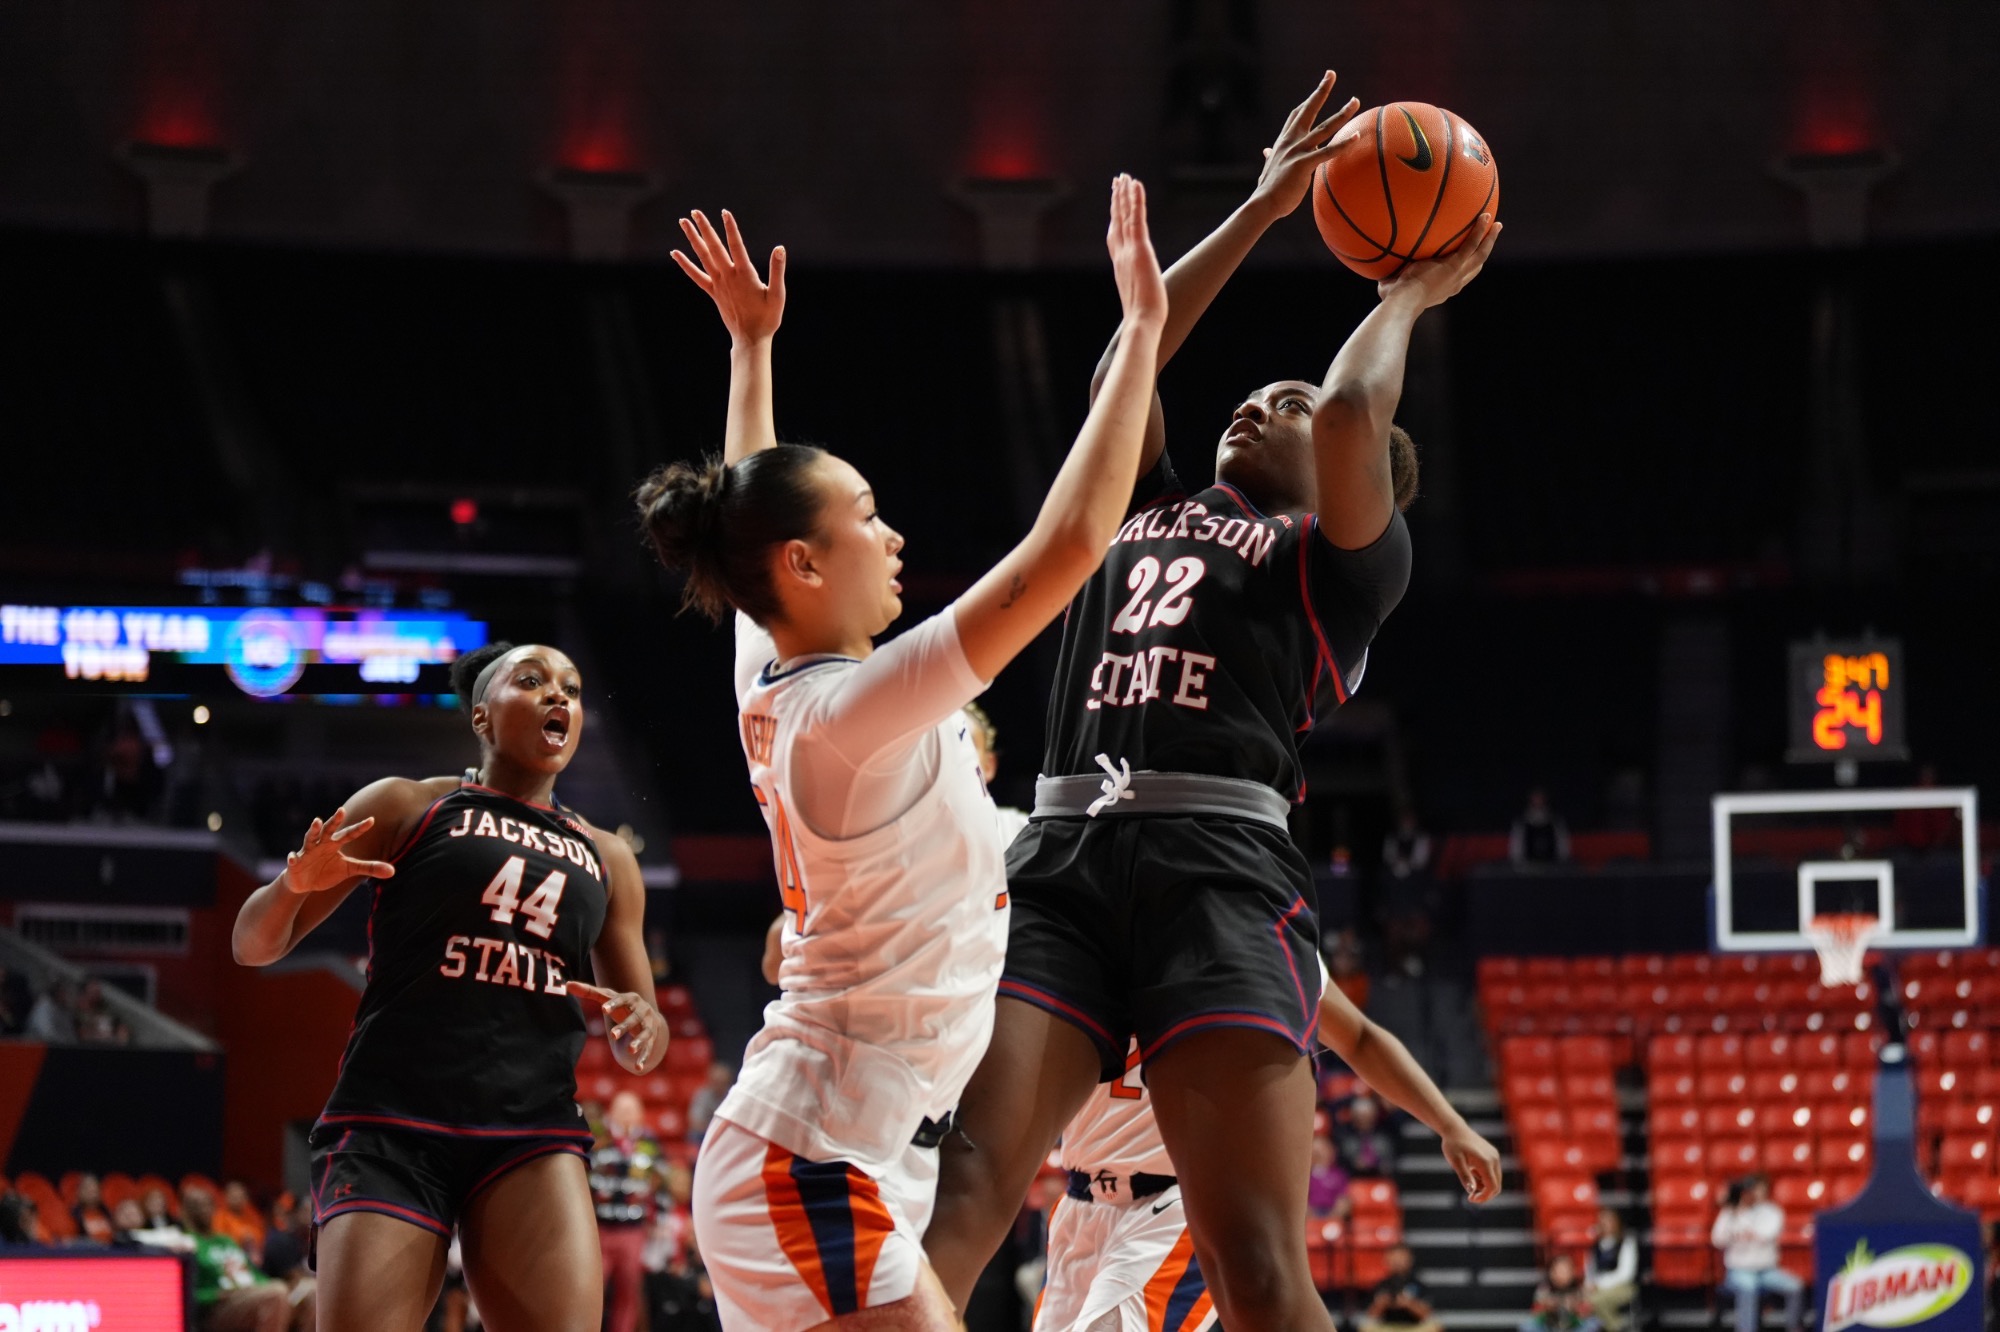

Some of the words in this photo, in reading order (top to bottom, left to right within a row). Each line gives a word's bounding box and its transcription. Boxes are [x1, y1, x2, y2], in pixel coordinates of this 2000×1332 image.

[1111, 555, 1206, 635] 22
[1086, 646, 1217, 710] STATE
[1813, 687, 1882, 749] 24
[449, 808, 602, 882] JACKSON
[481, 854, 568, 940] 44
[440, 935, 567, 996] STATE
[1828, 1258, 1956, 1325] LIBMAN
